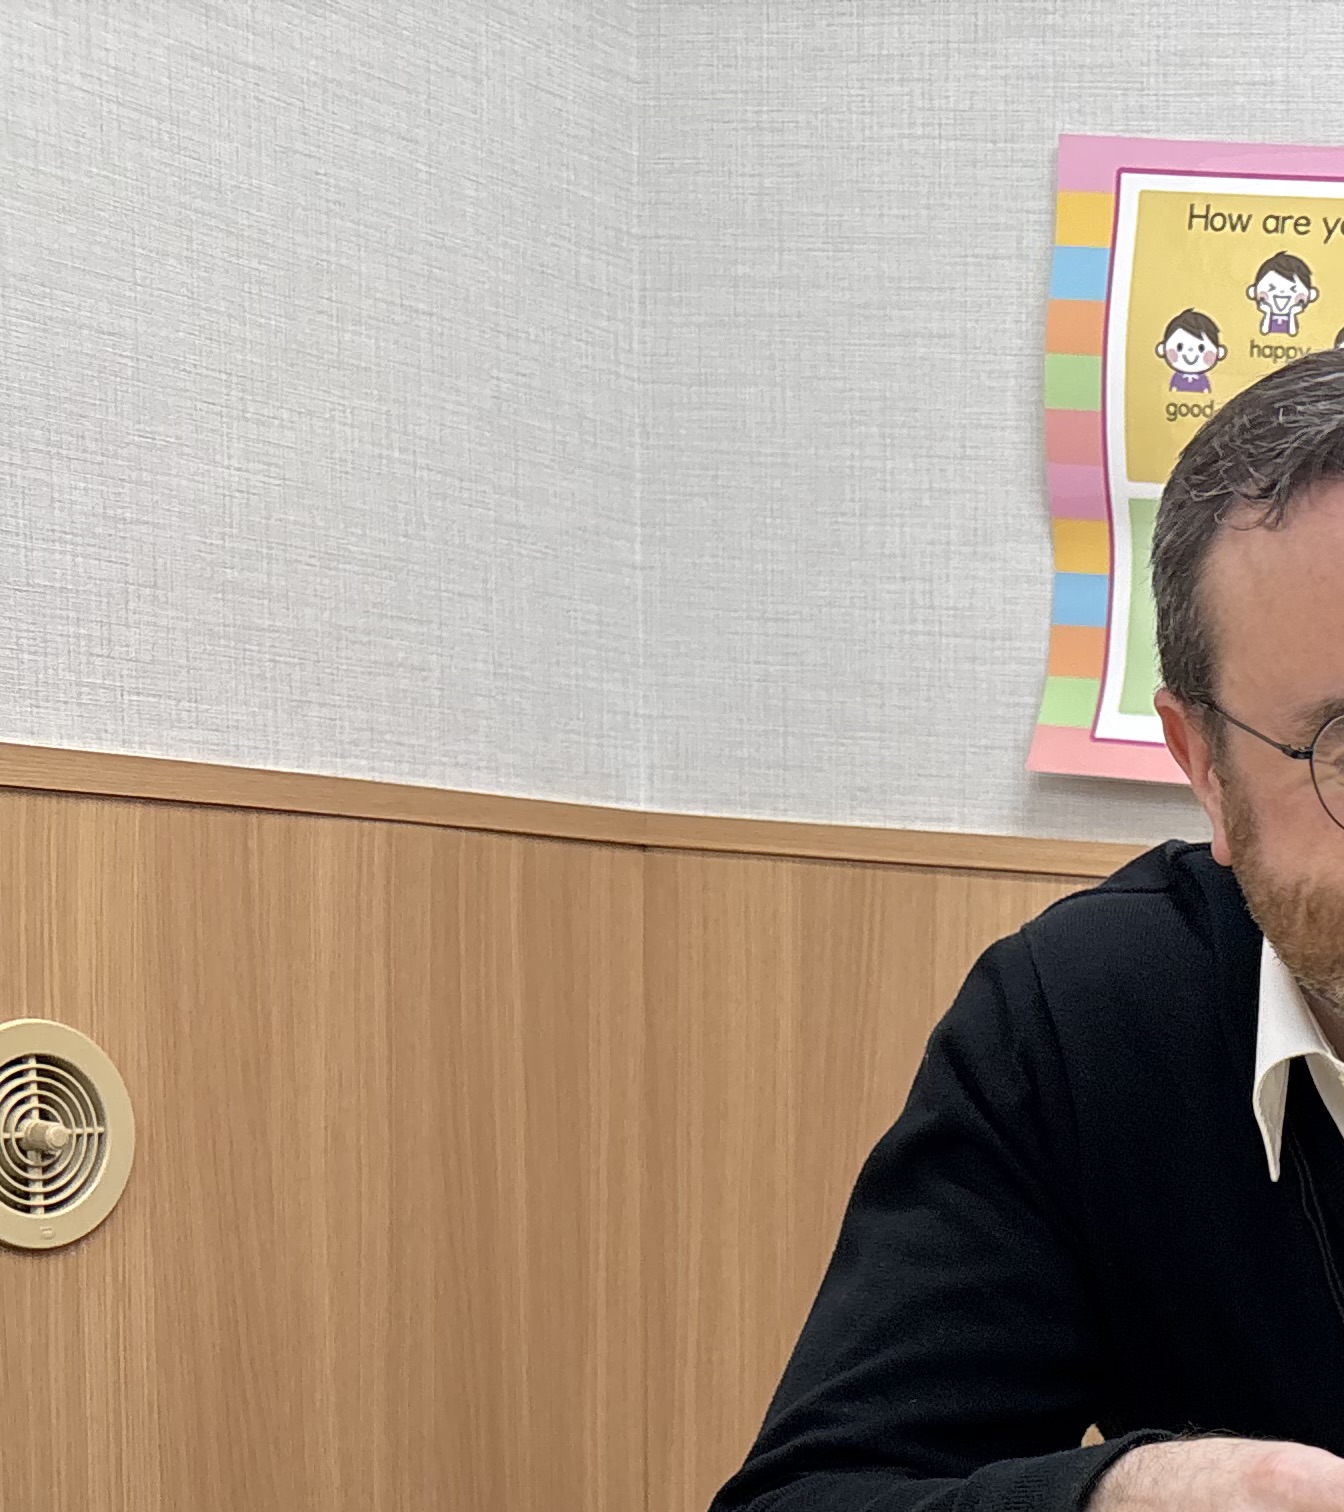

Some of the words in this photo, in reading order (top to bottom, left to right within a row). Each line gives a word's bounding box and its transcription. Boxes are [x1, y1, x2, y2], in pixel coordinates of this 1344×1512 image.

[1187, 203, 1252, 233] How
[1262, 213, 1312, 235] are
[1165, 400, 1215, 422] good
